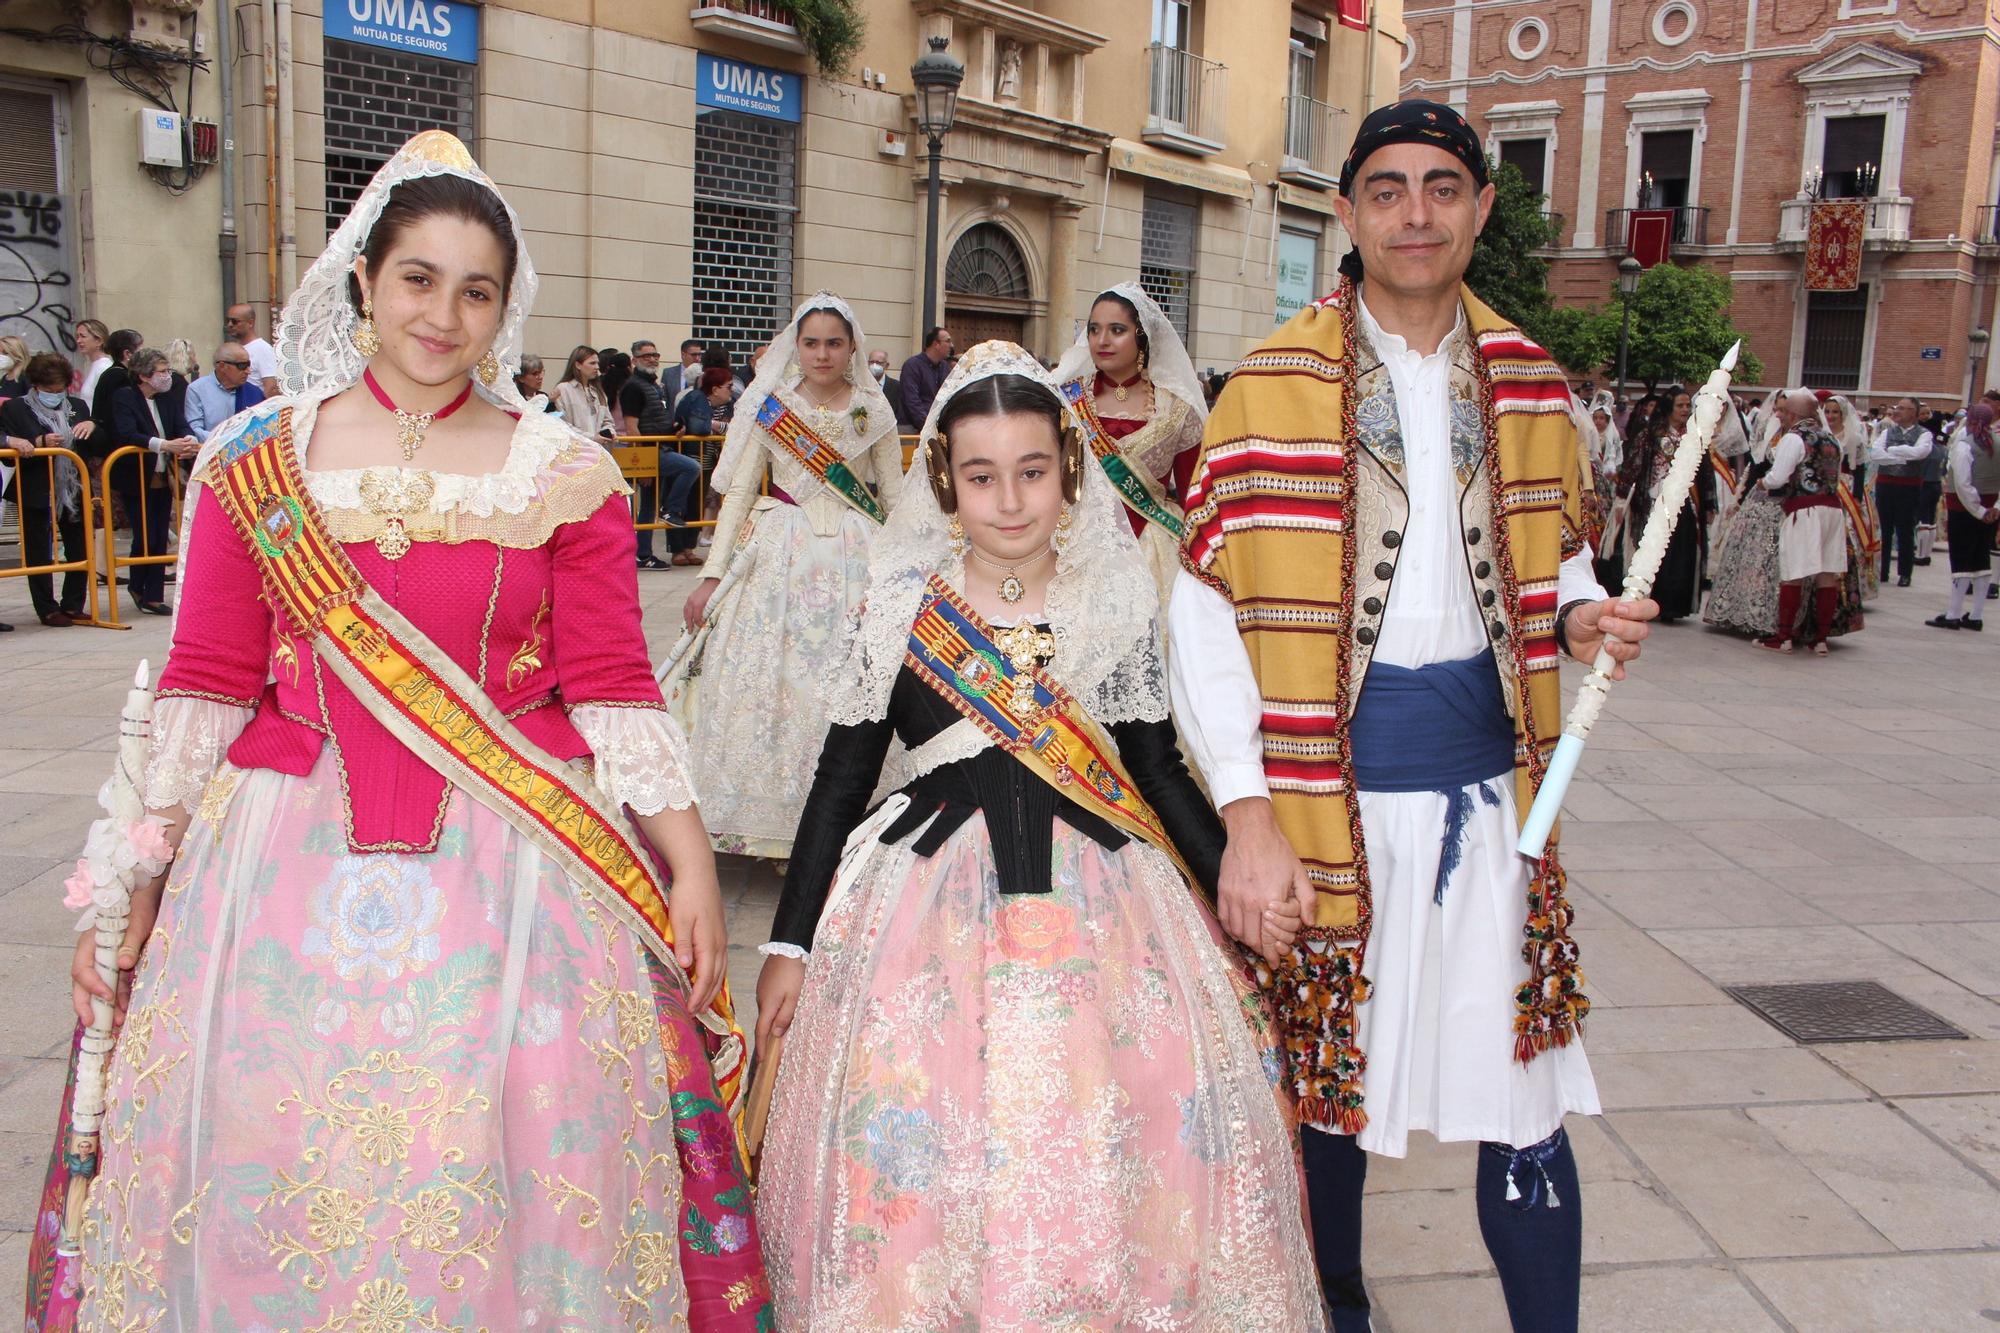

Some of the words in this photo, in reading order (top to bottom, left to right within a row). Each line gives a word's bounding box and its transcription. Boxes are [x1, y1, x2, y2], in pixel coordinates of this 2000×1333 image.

[348, 0, 451, 37] UMAS
[353, 25, 388, 41] MUTUA
[390, 33, 403, 44] DE
[404, 36, 448, 52] SEGUROS
[712, 61, 784, 102] UMAS
[714, 93, 740, 106] MUTUA
[741, 98, 750, 108] DE
[751, 100, 781, 114] SEGUROS
[1275, 295, 1299, 310] Oficina
[923, 621, 960, 662] 2022
[391, 671, 538, 794] FALLERA
[524, 787, 635, 881] MAJOR
